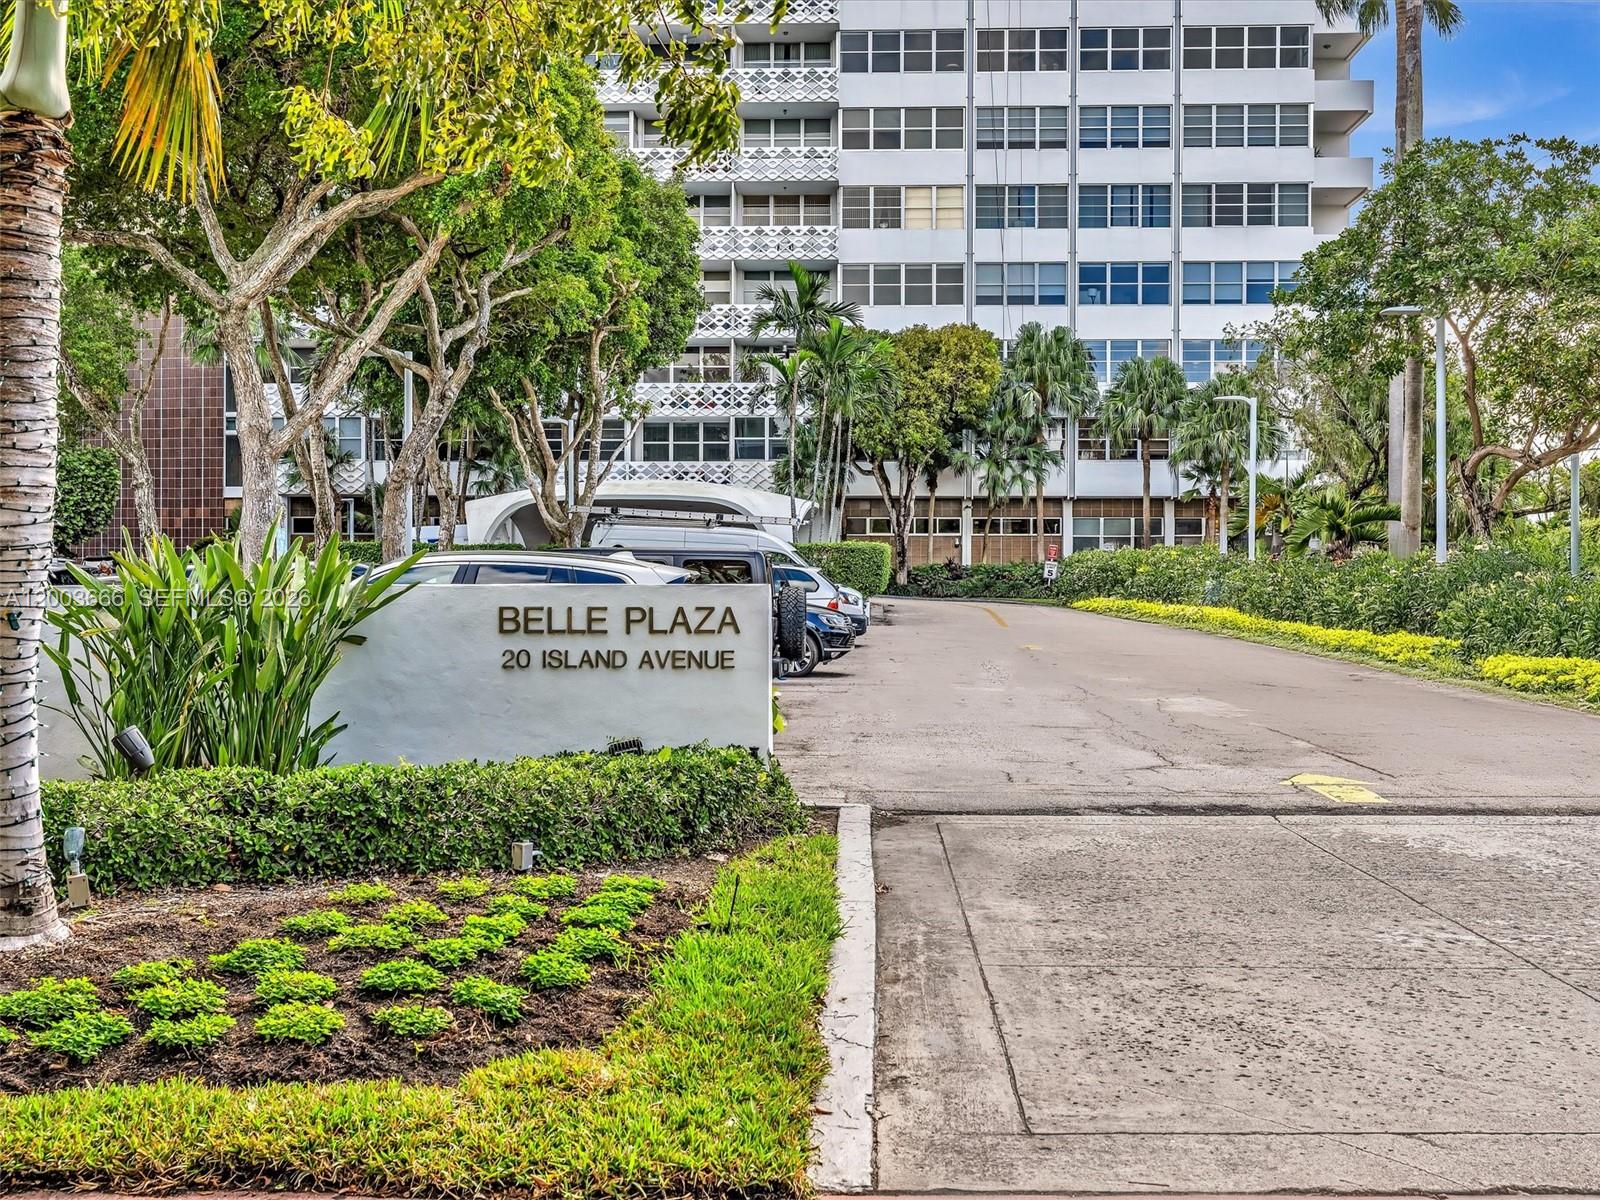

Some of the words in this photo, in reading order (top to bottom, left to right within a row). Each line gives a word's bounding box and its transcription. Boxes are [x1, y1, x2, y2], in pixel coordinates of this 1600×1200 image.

[1047, 569, 1053, 577] 5
[498, 606, 609, 635] BELLE
[625, 606, 741, 635] PLAZA
[501, 649, 531, 669] 20
[542, 650, 628, 669] ISLAND
[638, 650, 736, 669] AVENUE
